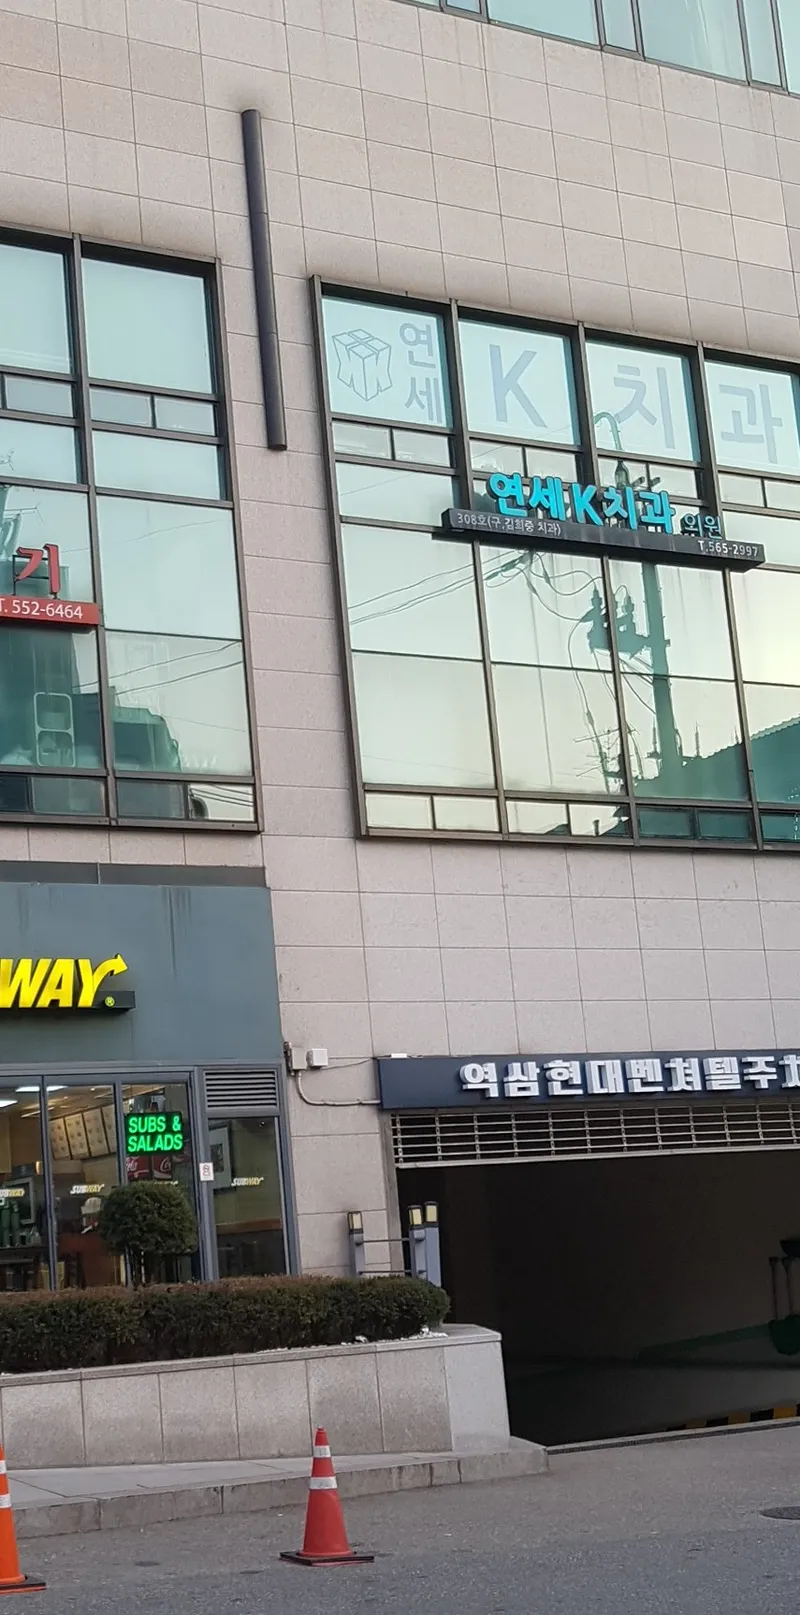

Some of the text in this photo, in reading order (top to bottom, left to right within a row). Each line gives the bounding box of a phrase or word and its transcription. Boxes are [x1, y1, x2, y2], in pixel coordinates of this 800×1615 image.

[683, 512, 723, 540] 의원
[15, 543, 61, 594] 기
[11, 599, 83, 619] 552-6464
[128, 1115, 182, 1133] SUBS &
[127, 1134, 183, 1152] SALADS
[69, 1184, 105, 1195] SUBWAY
[231, 1176, 264, 1187] SUBWAY
